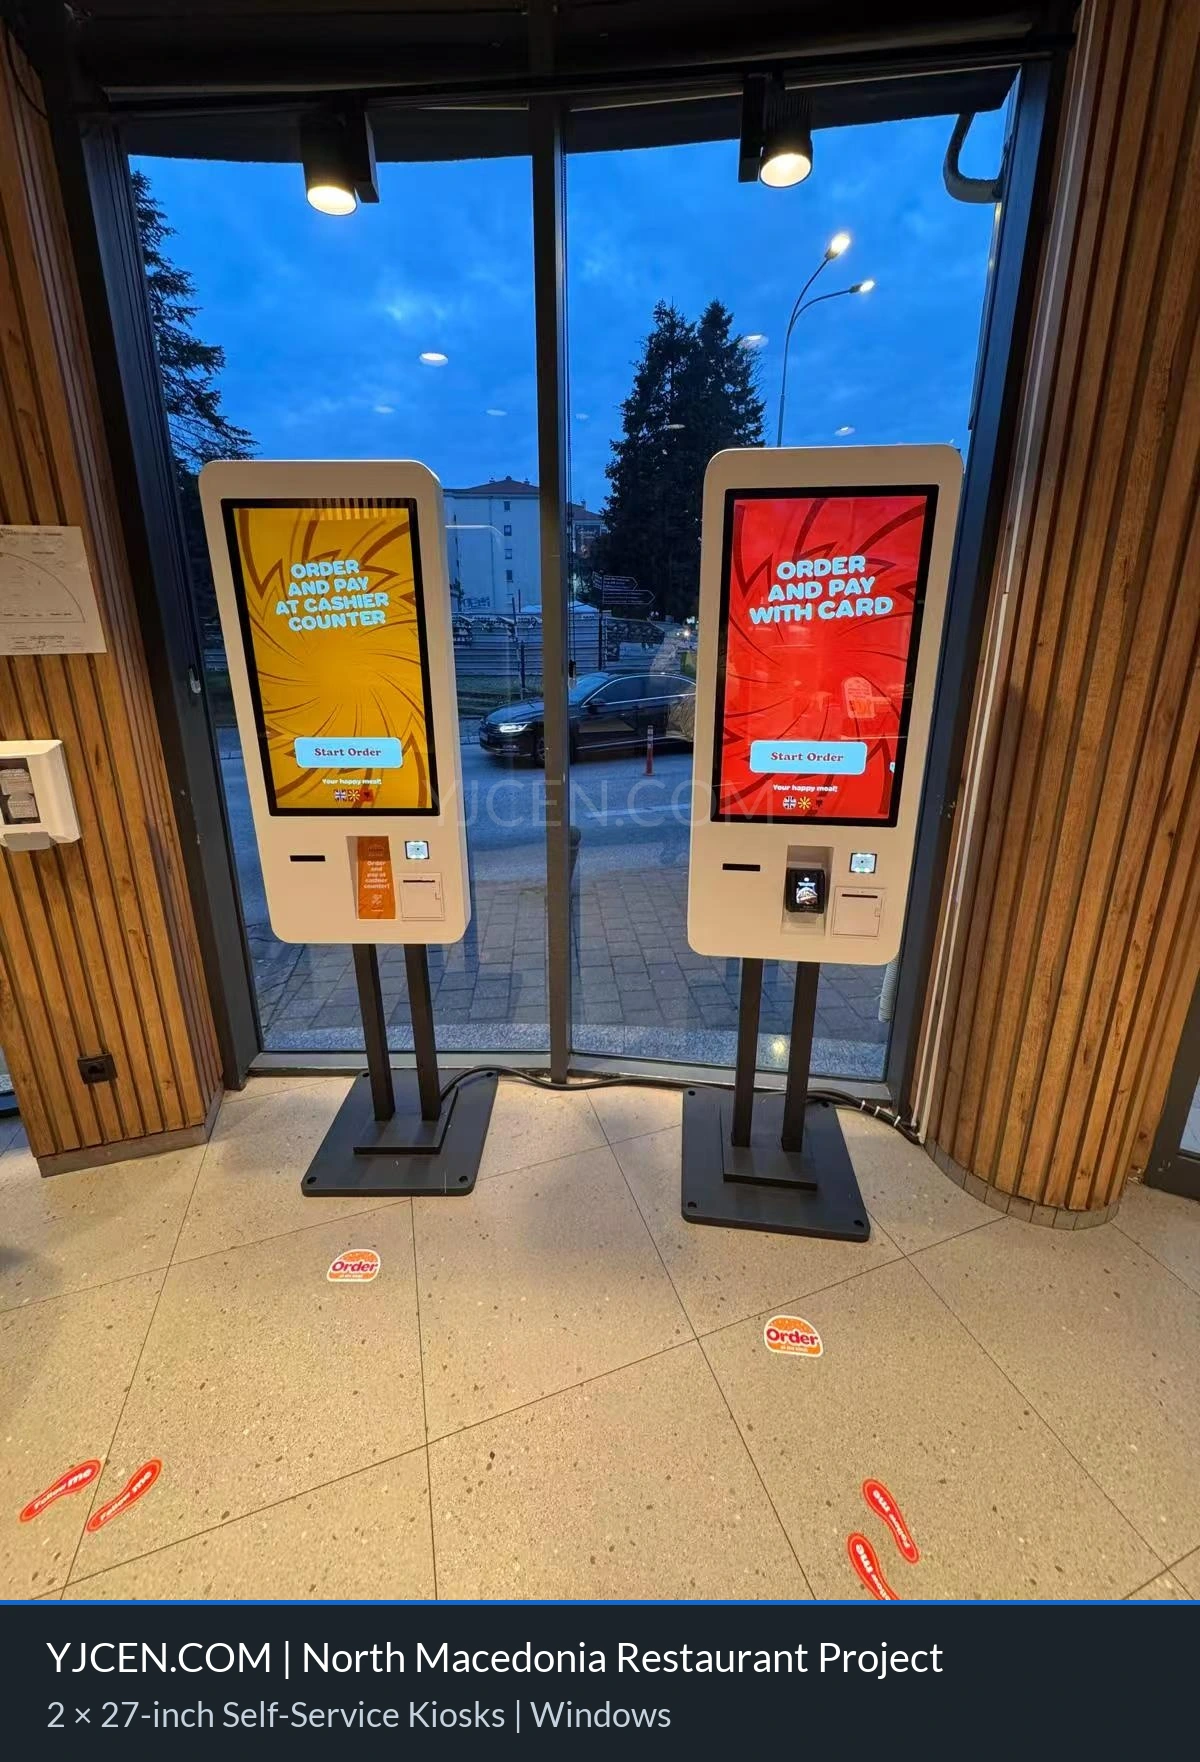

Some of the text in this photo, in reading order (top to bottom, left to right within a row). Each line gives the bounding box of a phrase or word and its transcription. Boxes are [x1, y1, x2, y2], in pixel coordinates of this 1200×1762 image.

[290, 559, 360, 579] ORDER
[777, 555, 866, 580] ORDER
[288, 576, 369, 597] AND PAY
[767, 576, 876, 602] AND PAY
[275, 592, 390, 615] AT CASHIER
[749, 596, 894, 625] WITH CARD
[288, 609, 387, 632] COUNTER
[314, 747, 382, 757] Start Order
[770, 751, 844, 762] Start Order
[339, 778, 361, 786] happy
[772, 784, 791, 792] Your
[791, 784, 816, 793] happy
[332, 1261, 378, 1272] Order
[766, 1328, 818, 1345] Order
[34, 1468, 93, 1510] Follow me
[100, 1471, 153, 1521] Follow me
[873, 1490, 911, 1548] Follow me
[855, 1543, 874, 1573] me
